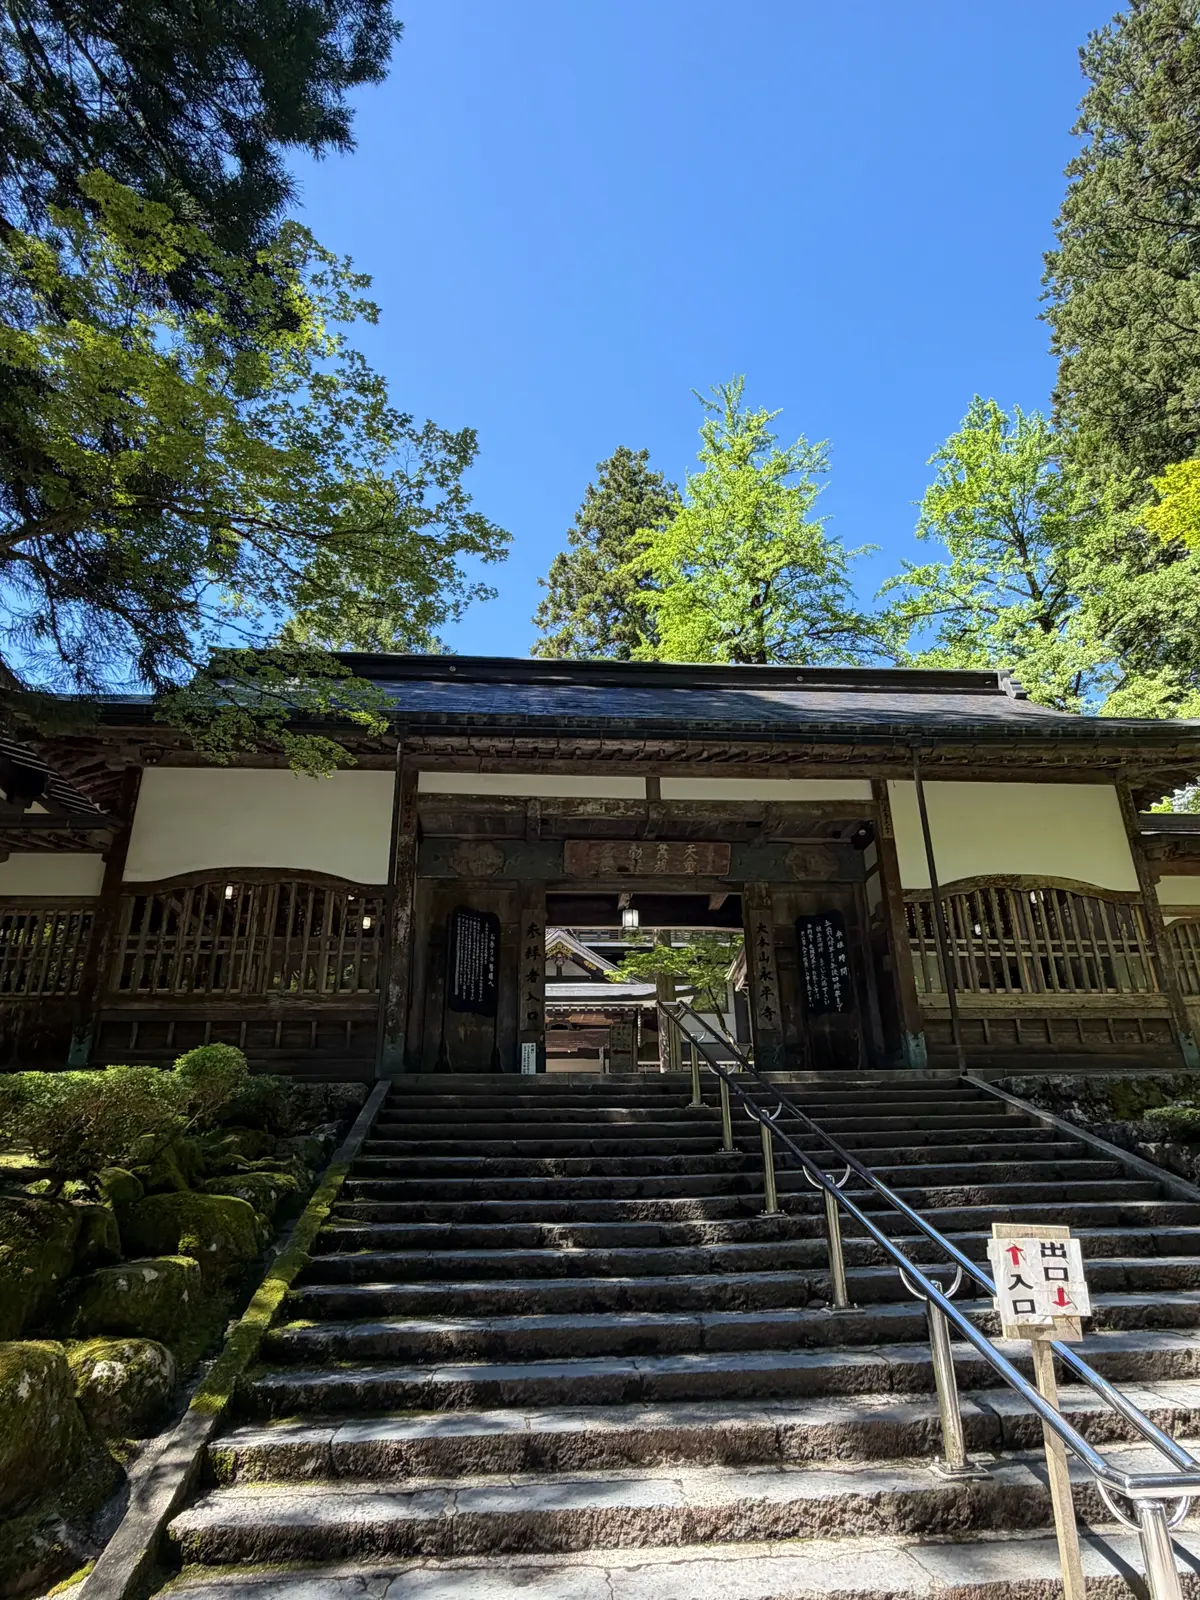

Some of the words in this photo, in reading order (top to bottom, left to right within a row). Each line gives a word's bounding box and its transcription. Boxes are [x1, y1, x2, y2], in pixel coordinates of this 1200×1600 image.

[525, 922, 542, 1020] 参拝者入口
[757, 922, 776, 1021] 大本山永平寺
[1008, 1274, 1036, 1315] 入口
[1040, 1242, 1069, 1282] 出口
